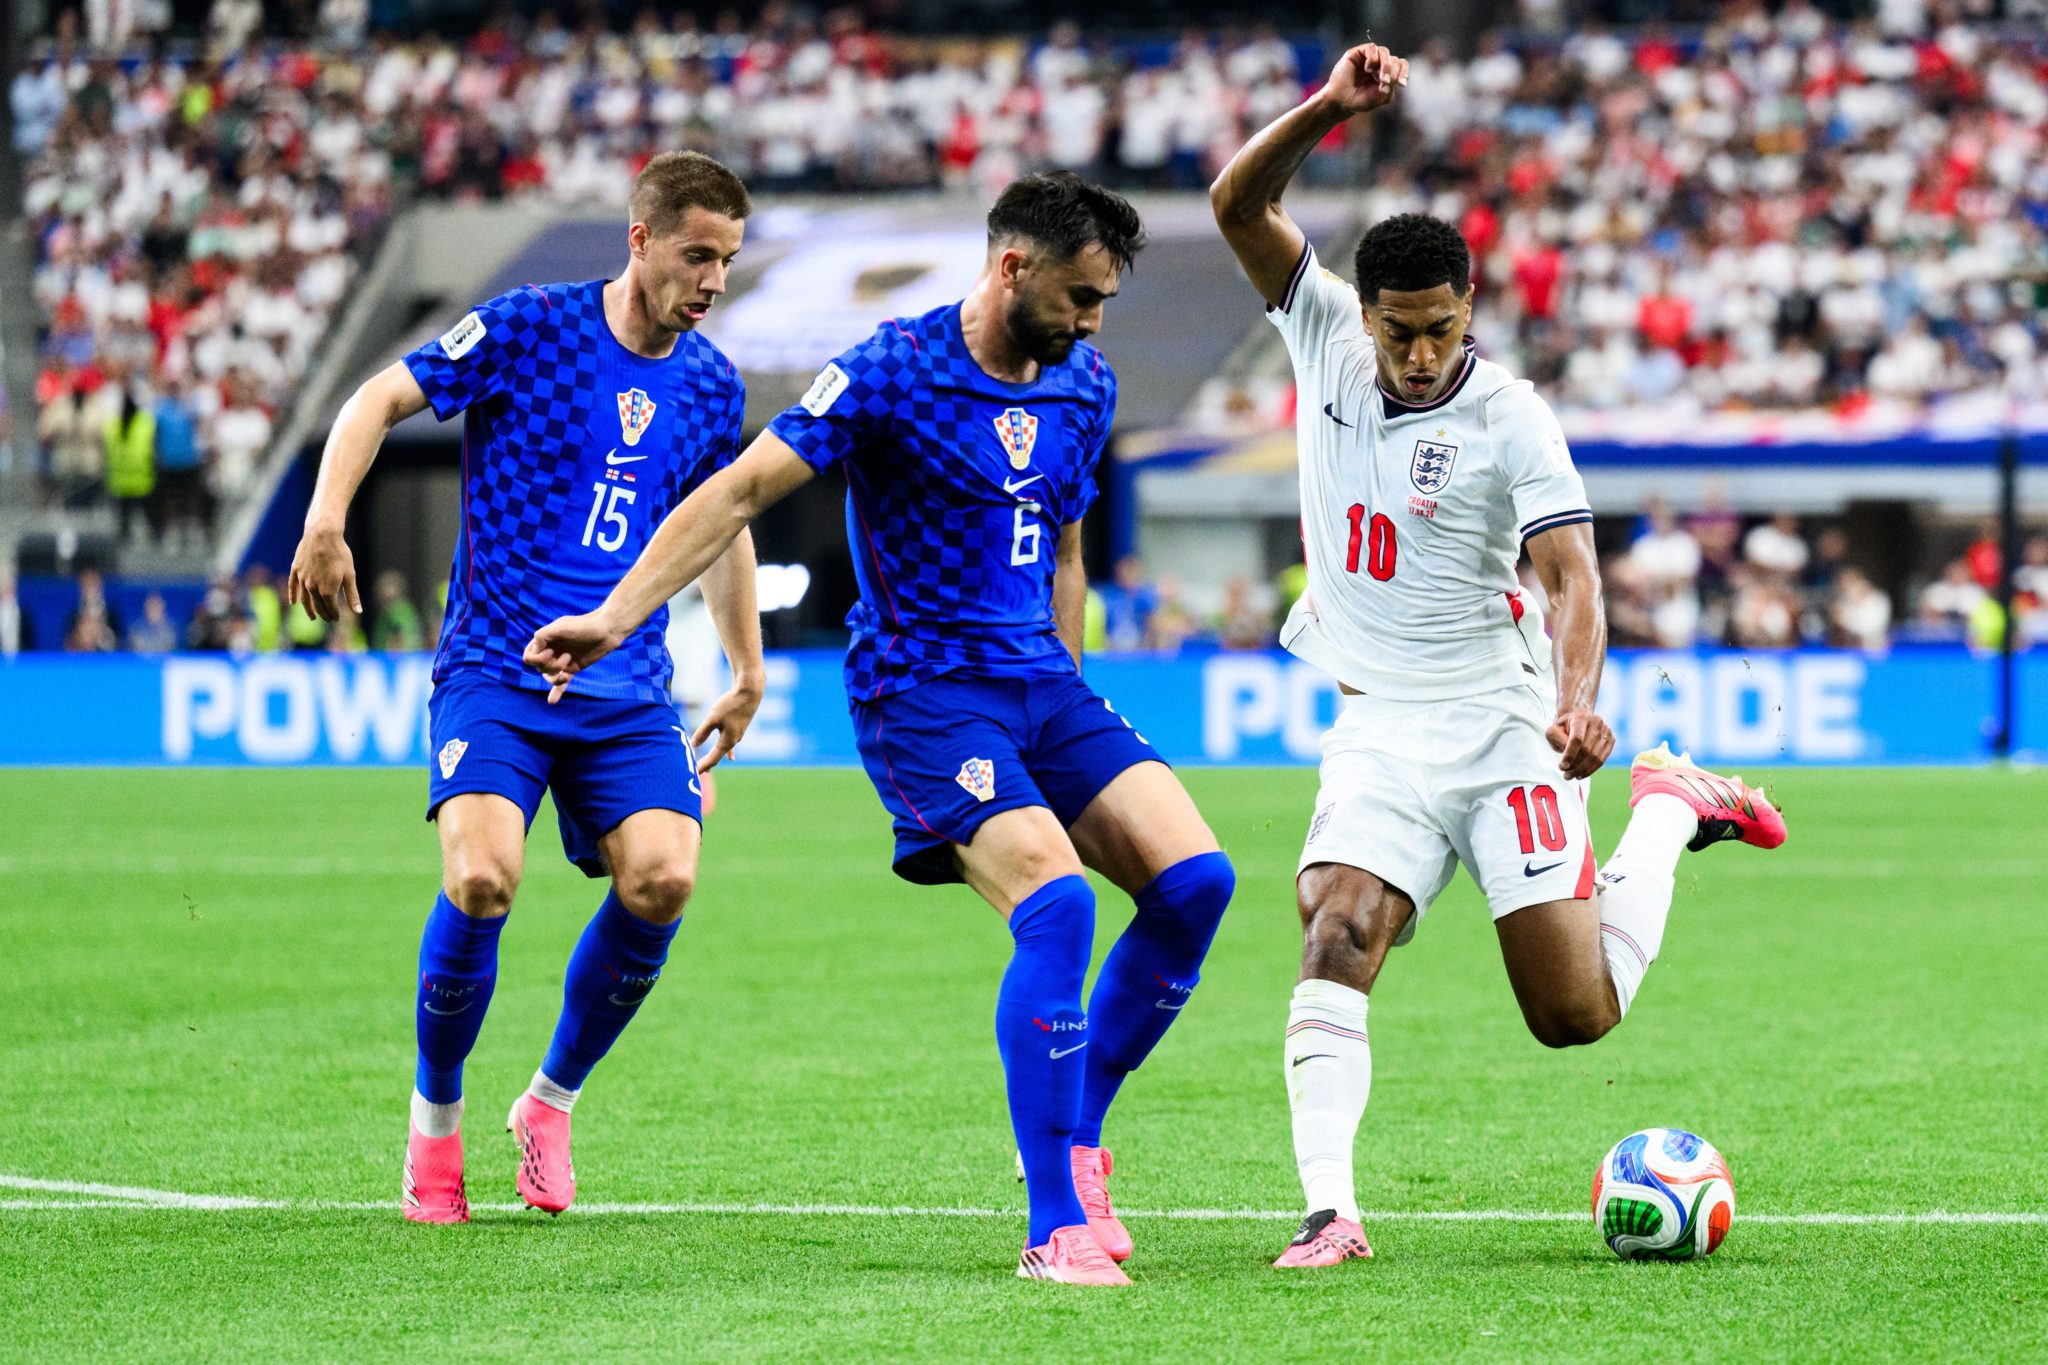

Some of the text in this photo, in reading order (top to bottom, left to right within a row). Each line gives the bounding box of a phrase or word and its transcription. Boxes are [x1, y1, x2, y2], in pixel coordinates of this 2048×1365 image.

[581, 482, 637, 552] 15
[1011, 502, 1041, 567] 6
[1408, 495, 1438, 509] CROATIA
[1346, 502, 1397, 582] 10
[1507, 785, 1567, 854] 10
[1052, 1016, 1088, 1032] HNS
